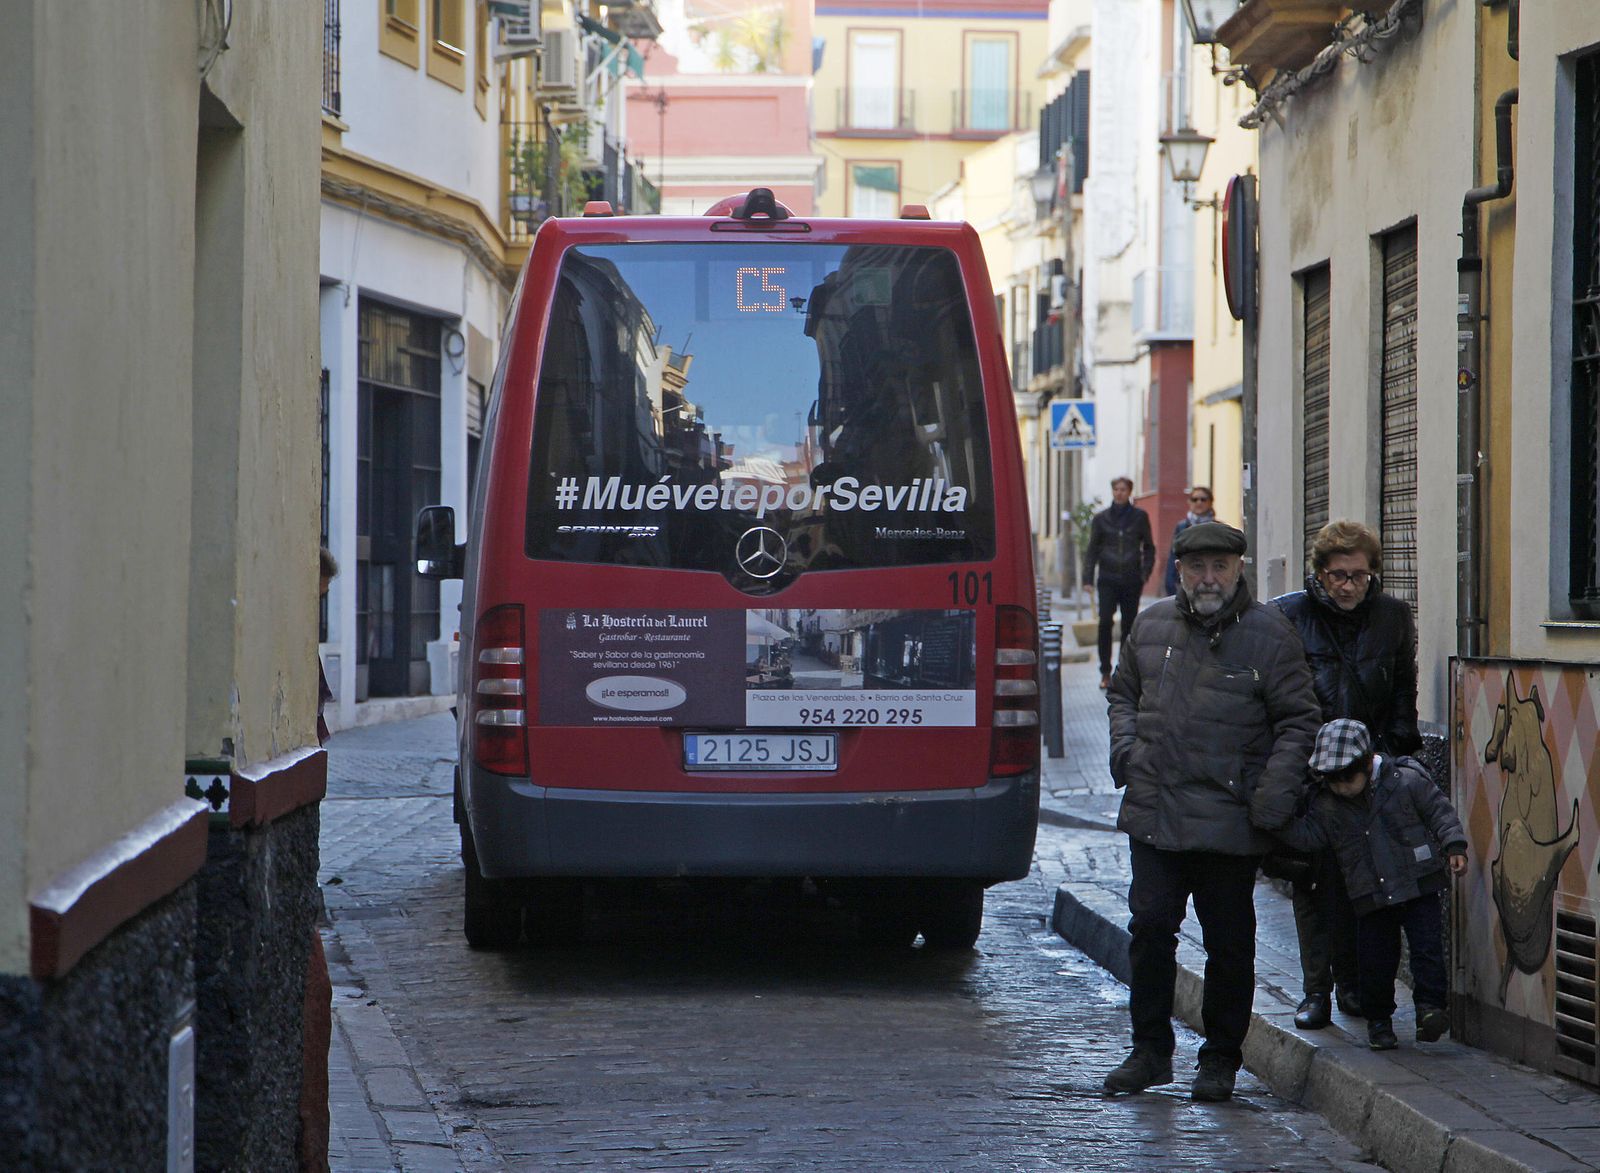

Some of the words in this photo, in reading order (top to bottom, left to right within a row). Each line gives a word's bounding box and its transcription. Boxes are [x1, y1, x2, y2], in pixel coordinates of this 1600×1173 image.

[737, 267, 785, 312] C5
[555, 475, 967, 519] #MuéveteporSevilla
[556, 525, 659, 533] SPRINTER
[874, 526, 966, 540] Mercedes-Benz
[947, 570, 993, 606] 101
[582, 614, 599, 628] La
[601, 614, 653, 630] Hostería
[654, 619, 667, 627] del
[668, 614, 708, 628] Laurel
[598, 632, 637, 643] Gastrobar
[643, 632, 691, 643] Restaurante
[605, 650, 629, 659] Sabor
[631, 650, 643, 659] de
[644, 650, 653, 659] la
[654, 650, 705, 661] gastronomía
[592, 661, 629, 669] sevillana
[629, 661, 656, 669] desde
[752, 693, 776, 702] Plaza
[778, 694, 790, 702] de
[792, 694, 804, 702] los
[860, 694, 866, 702] 5
[875, 694, 900, 702] Barrio
[902, 694, 914, 702] de
[916, 694, 942, 702] Santa
[943, 693, 964, 702] Cruz
[799, 708, 836, 725] 954
[842, 708, 880, 725] 220
[886, 708, 923, 725] 295
[703, 738, 770, 762] 2125
[781, 738, 830, 762] JSJ
